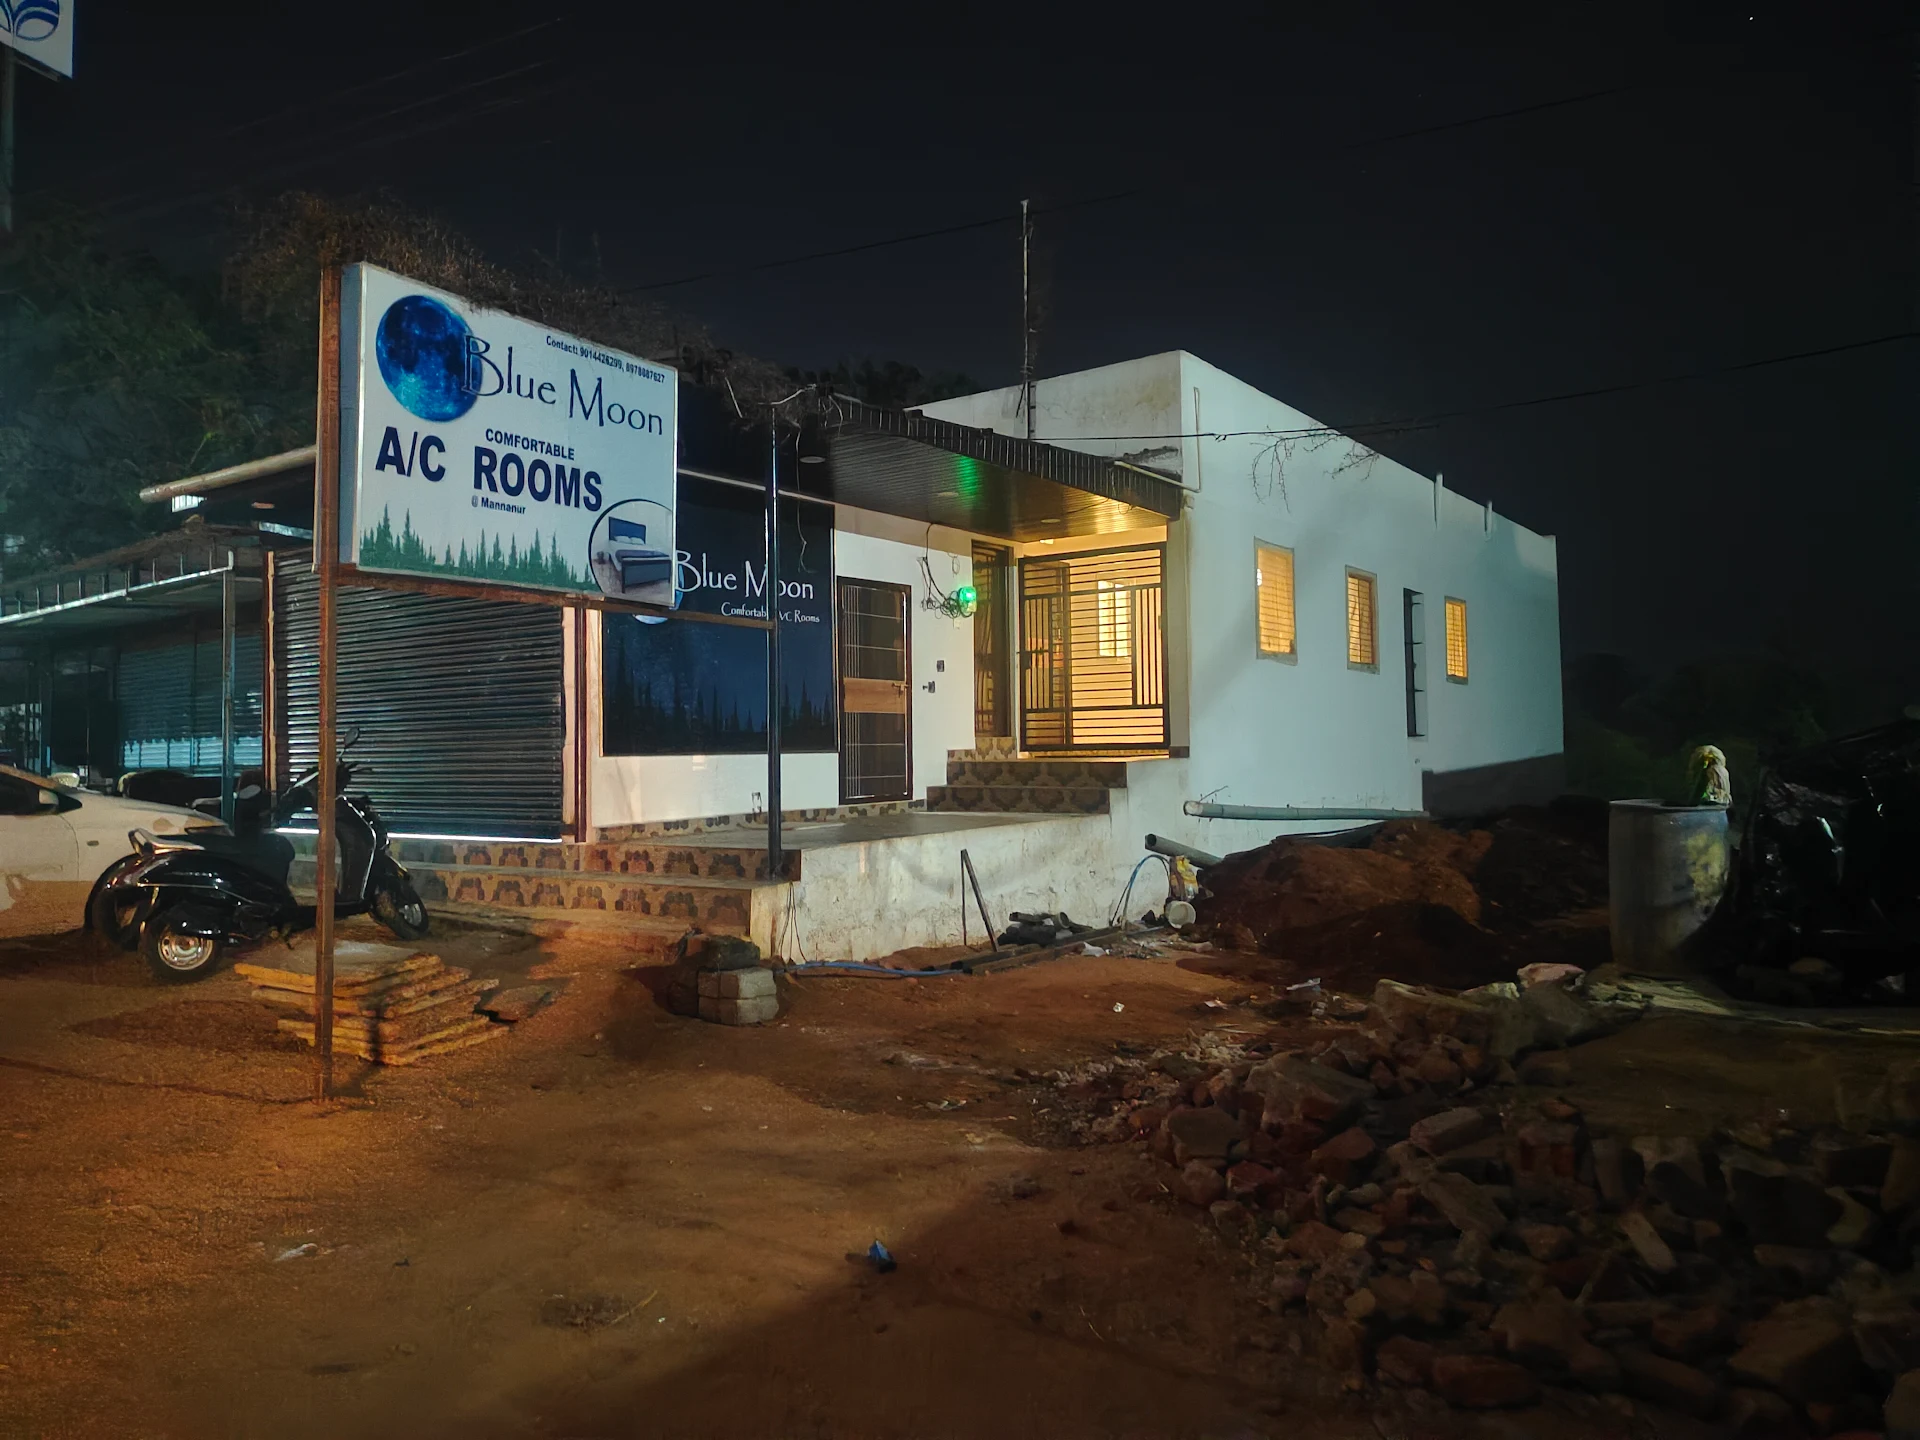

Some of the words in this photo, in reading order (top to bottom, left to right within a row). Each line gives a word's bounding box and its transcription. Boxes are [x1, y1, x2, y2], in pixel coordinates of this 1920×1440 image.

[461, 335, 557, 404] Blue
[569, 368, 663, 435] Moon
[485, 428, 575, 461] COMFORTABLE
[375, 426, 447, 482] A/C
[473, 446, 602, 512] ROOMS
[481, 497, 526, 514] Mannanur
[676, 550, 738, 592] Blue
[794, 609, 820, 623] Rooms
